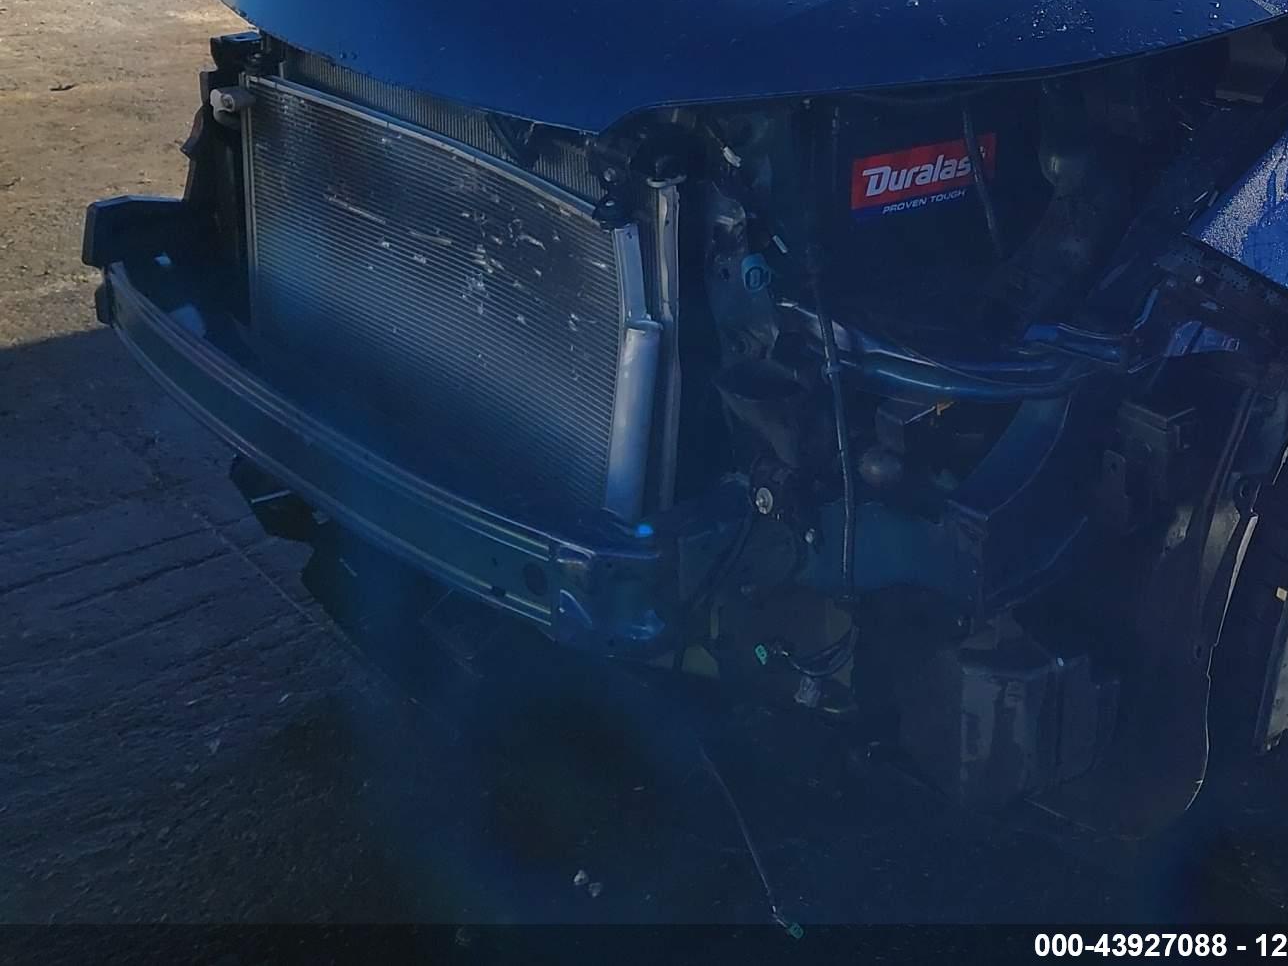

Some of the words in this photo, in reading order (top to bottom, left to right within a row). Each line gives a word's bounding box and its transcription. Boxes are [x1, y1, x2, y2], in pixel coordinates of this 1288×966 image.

[862, 150, 981, 197] Duralas
[882, 196, 927, 215] PROVEN
[930, 188, 967, 204] TOUGH
